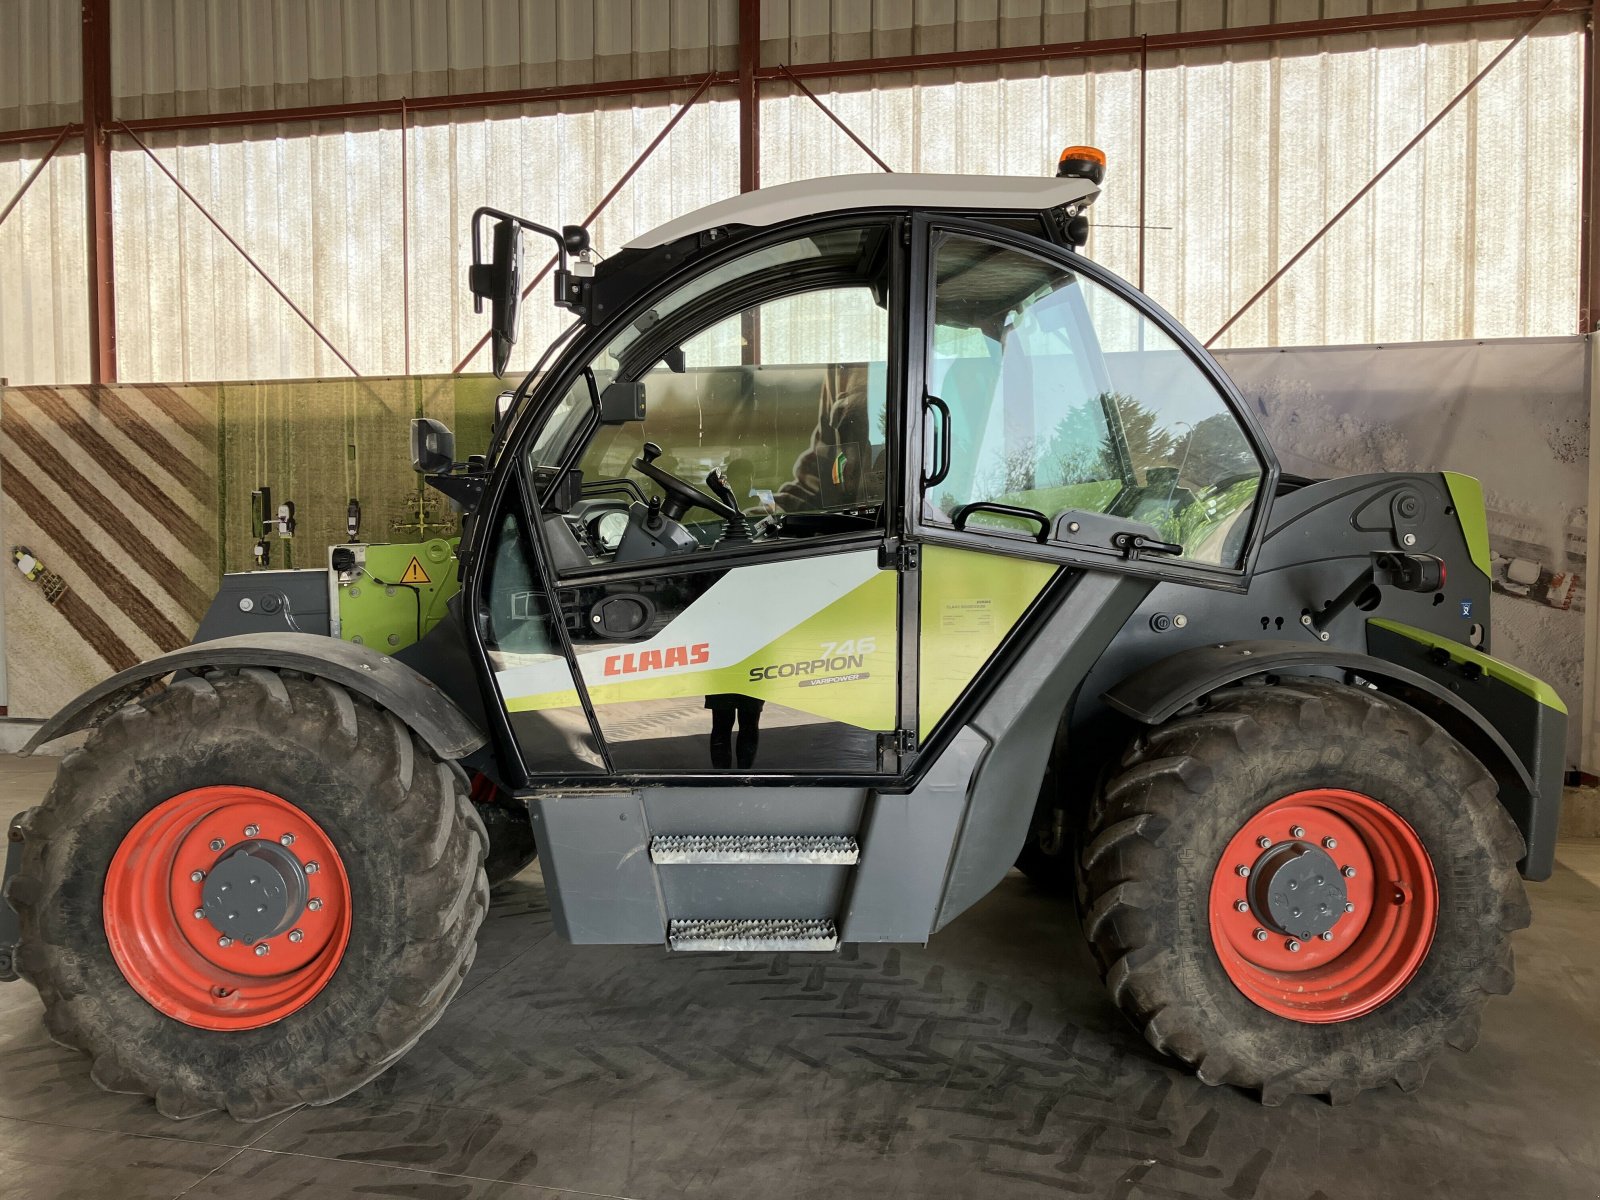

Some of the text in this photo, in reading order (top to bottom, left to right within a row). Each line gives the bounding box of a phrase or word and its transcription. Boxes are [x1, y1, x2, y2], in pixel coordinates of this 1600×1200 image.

[604, 643, 709, 676] CLAAS
[819, 636, 877, 662] 746
[749, 654, 864, 682] SCORPION
[810, 674, 860, 686] VARIPOWER
